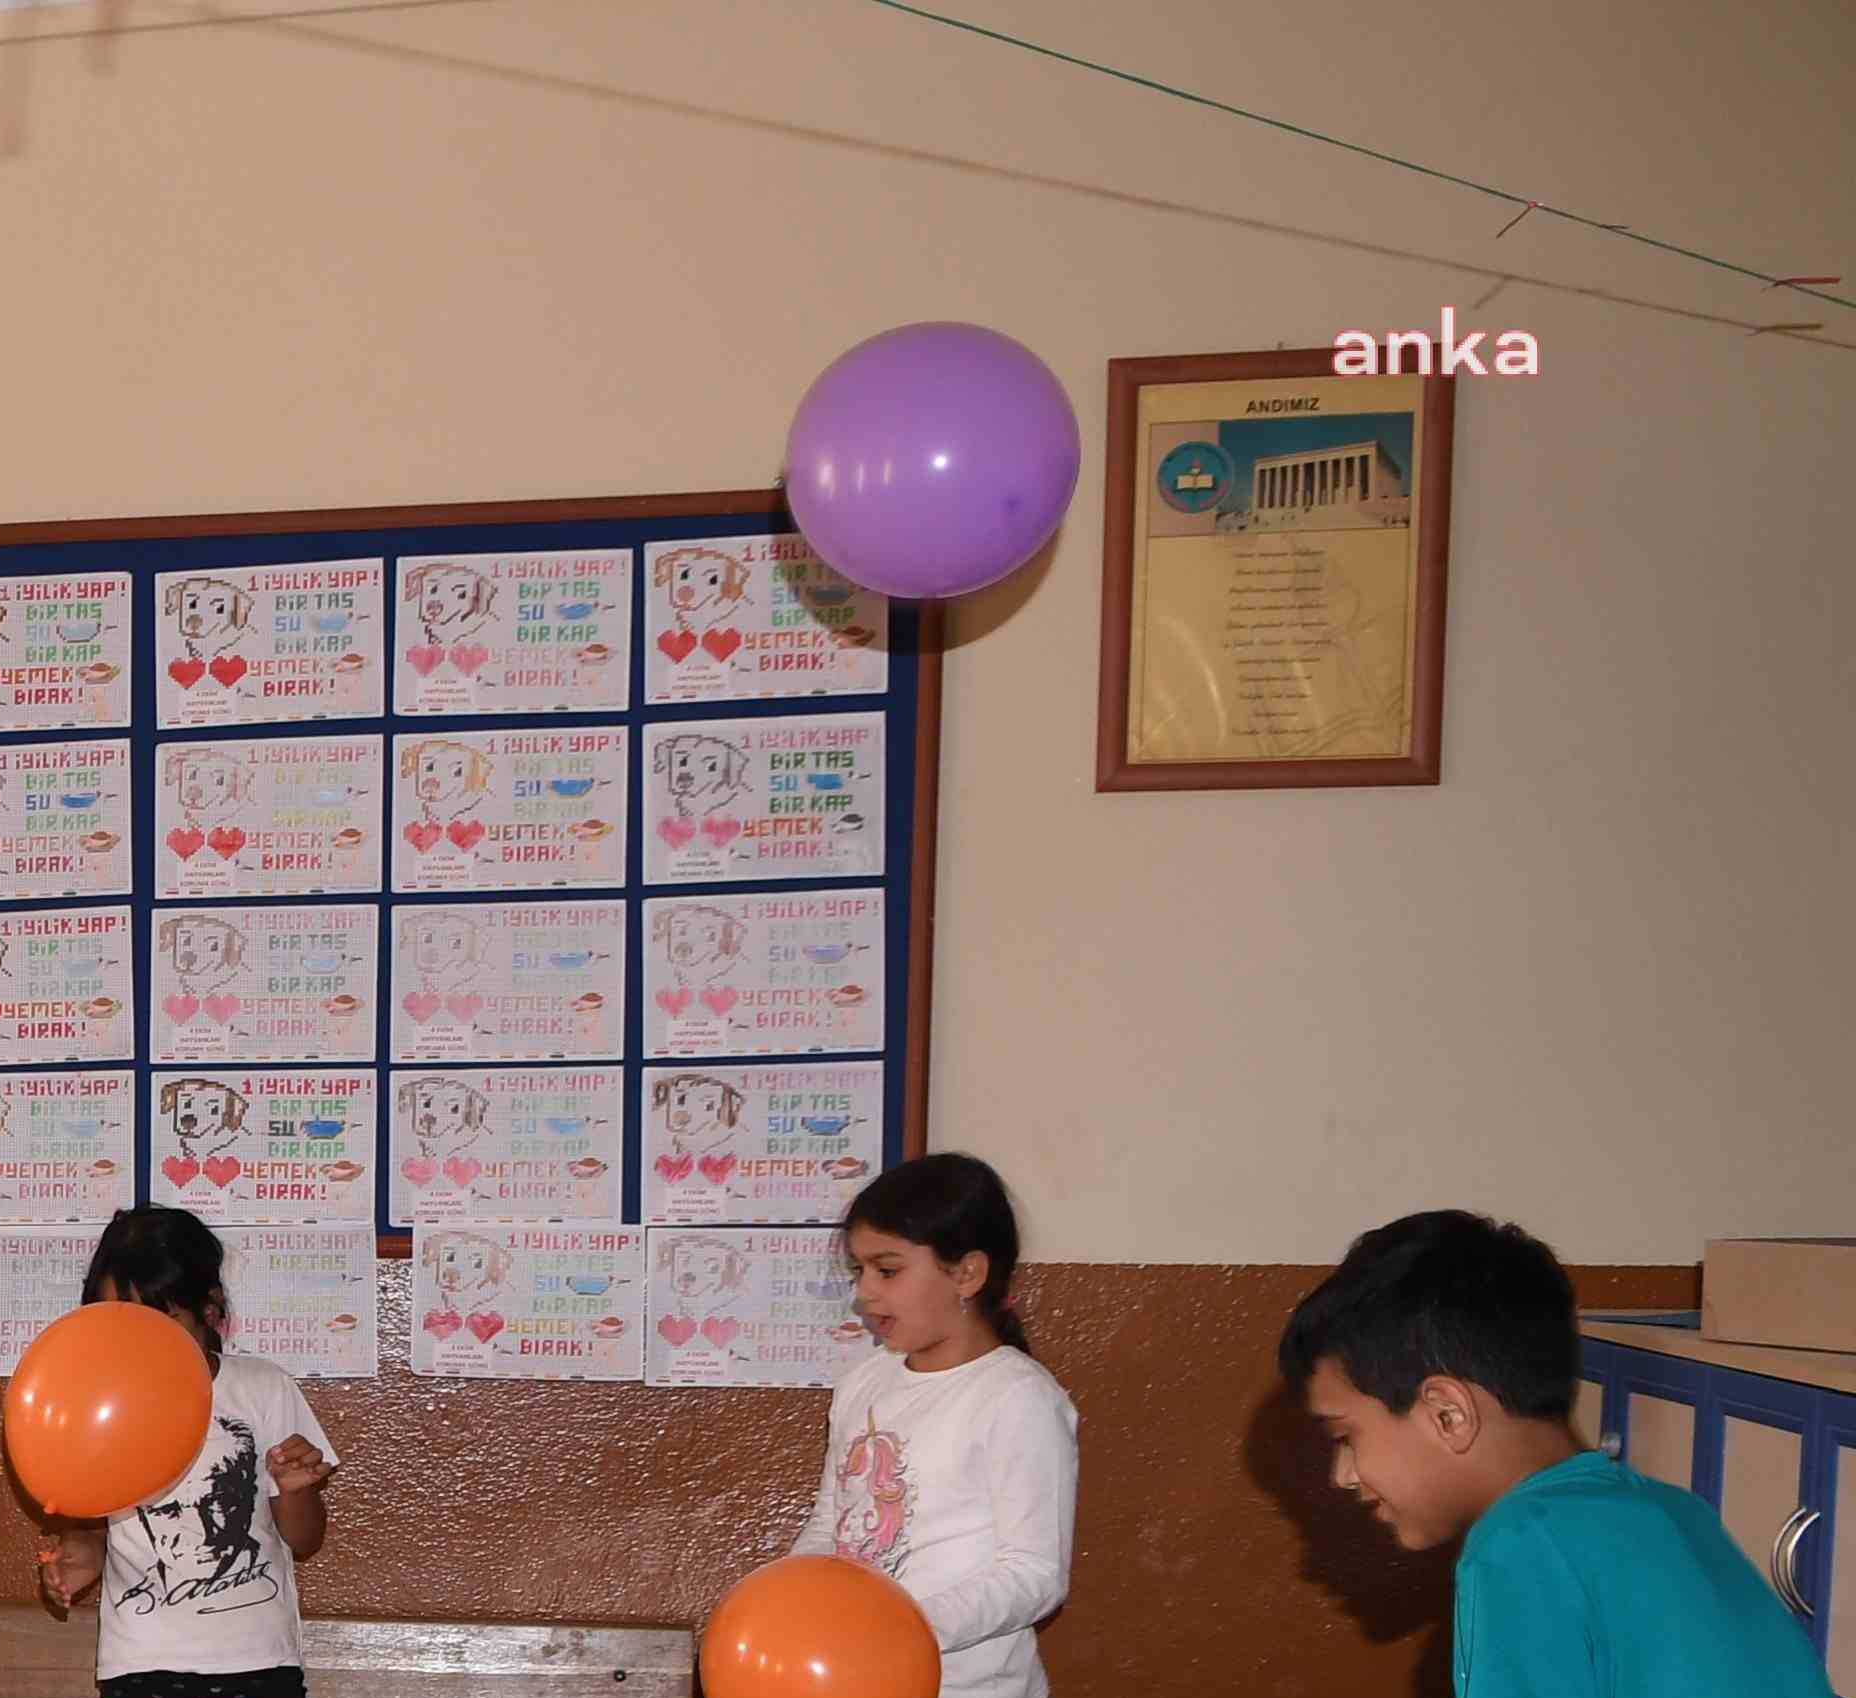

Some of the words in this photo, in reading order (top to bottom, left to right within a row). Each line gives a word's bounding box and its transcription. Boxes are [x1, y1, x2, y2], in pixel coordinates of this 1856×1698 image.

[1246, 397, 1320, 414] ANDIMIZ
[744, 629, 823, 650] YEMEK
[1, 665, 72, 685] YEMEK
[249, 656, 323, 677] YEMEK
[770, 772, 796, 789] SU
[488, 822, 564, 841] YEMEK
[743, 816, 822, 837] YEMEK
[1, 834, 73, 853] YEMEK
[248, 830, 322, 849] YEMEK
[4, 1000, 75, 1019] YEMEK
[268, 1119, 292, 1133] SU
[5, 1161, 77, 1179] YEMEK
[242, 1162, 316, 1178] YEMEK
[484, 1159, 560, 1178] YEMEK
[739, 1159, 818, 1177] YEMEK
